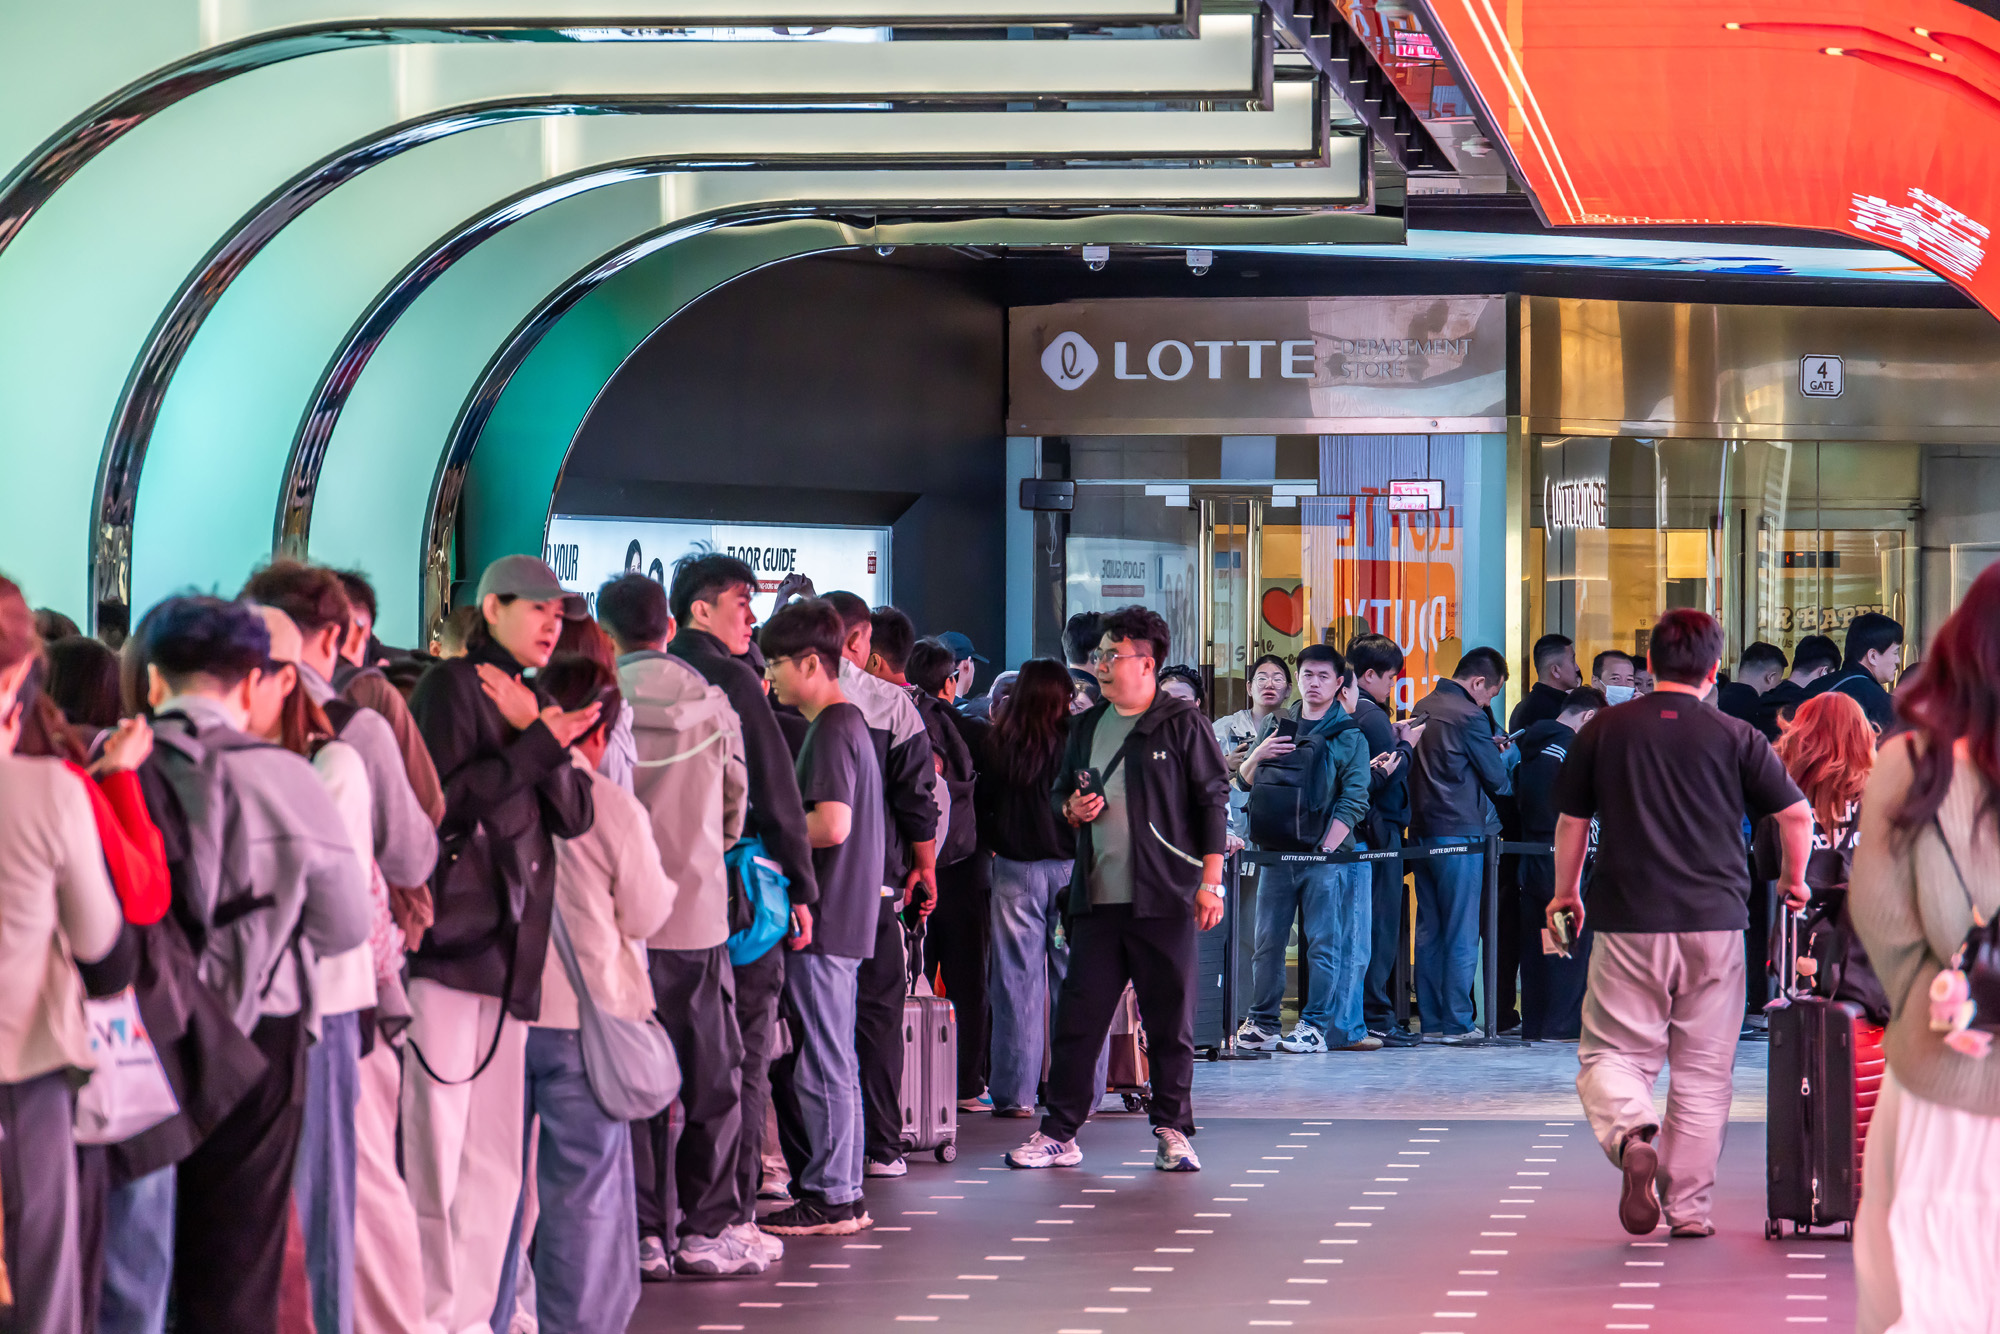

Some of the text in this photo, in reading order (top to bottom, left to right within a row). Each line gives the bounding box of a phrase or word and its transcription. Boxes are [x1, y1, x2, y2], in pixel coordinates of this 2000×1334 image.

[1340, 338, 1473, 357] DEPARTMENT
[1114, 340, 1317, 381] LOTTE
[1341, 361, 1403, 379] STORE
[1817, 361, 1828, 379] 4
[1810, 380, 1834, 391] GATE
[553, 543, 579, 581] YOUR
[763, 547, 797, 572] GUIDE
